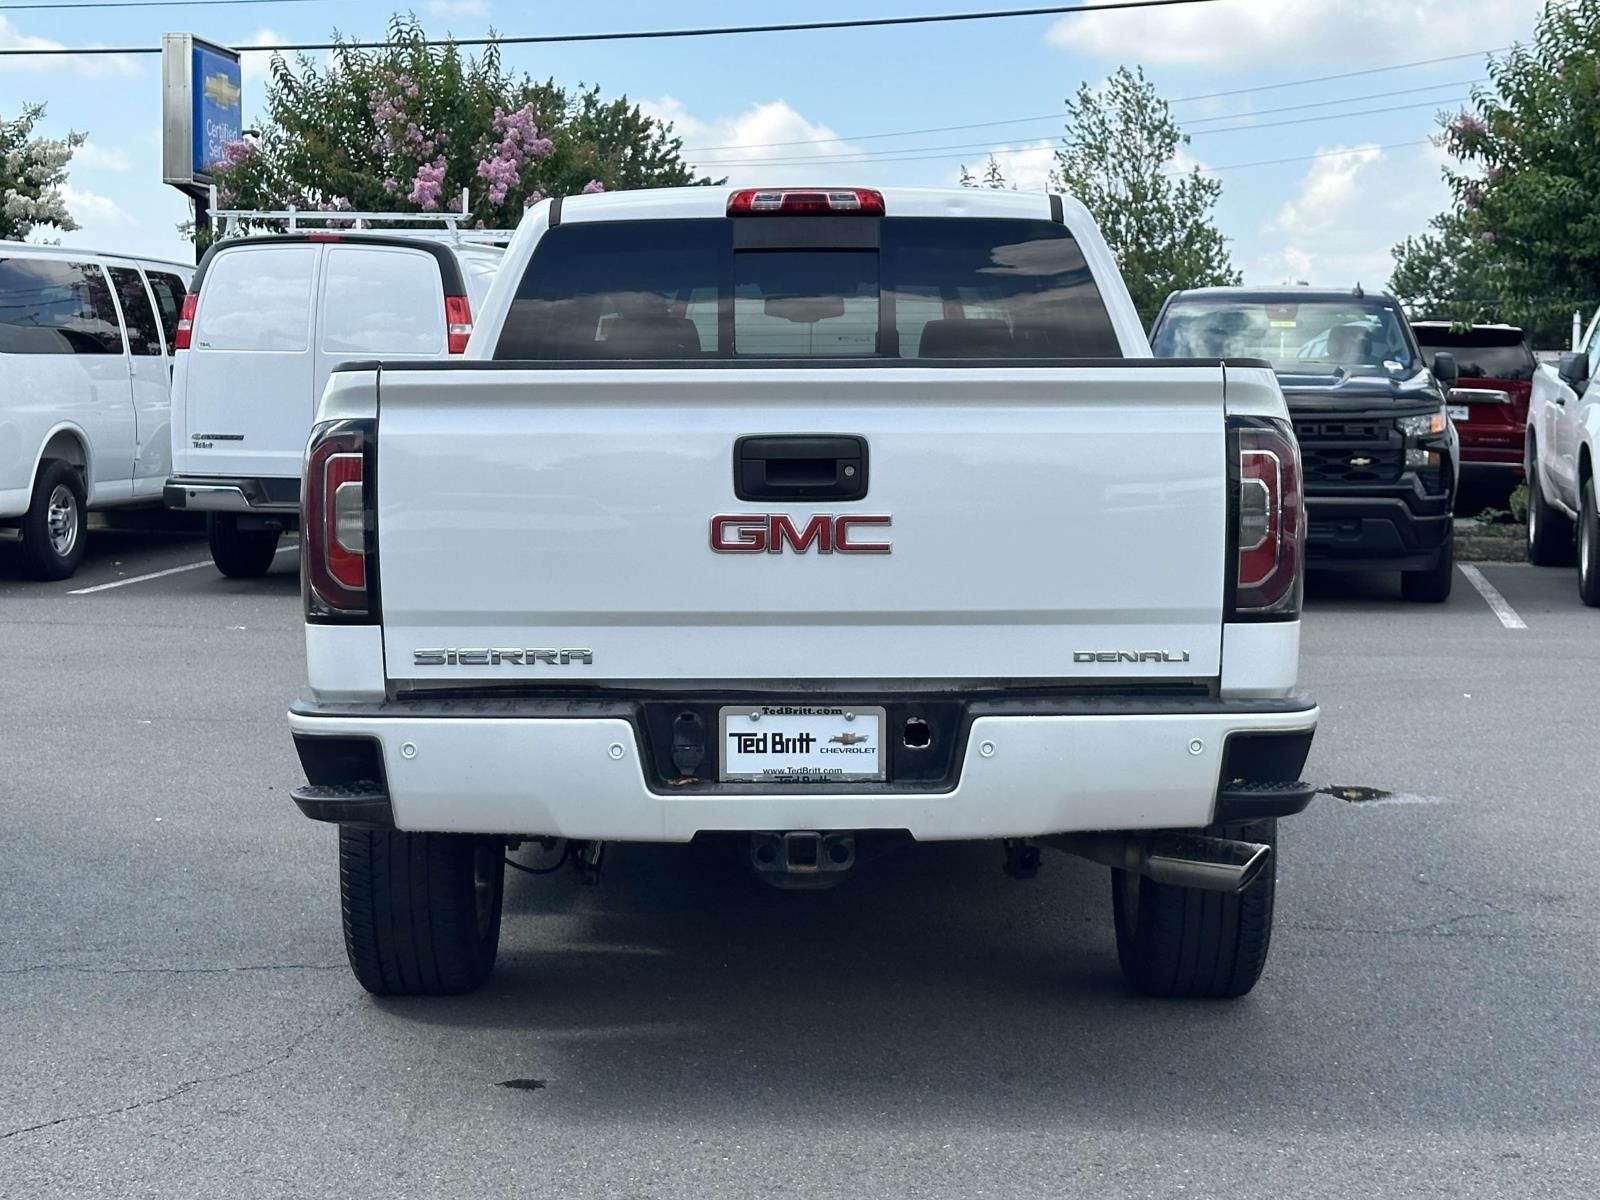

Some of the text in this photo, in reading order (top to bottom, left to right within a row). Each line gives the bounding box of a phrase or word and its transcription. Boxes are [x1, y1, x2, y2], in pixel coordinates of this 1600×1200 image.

[206, 118, 238, 142] Certified
[709, 513, 892, 555] GMC
[413, 647, 593, 666] SIERRA
[1073, 649, 1190, 663] DENALI
[761, 706, 843, 716] TedBritt.com
[729, 732, 817, 754] Ted Britt
[762, 766, 843, 775] www.TedBritt.com
